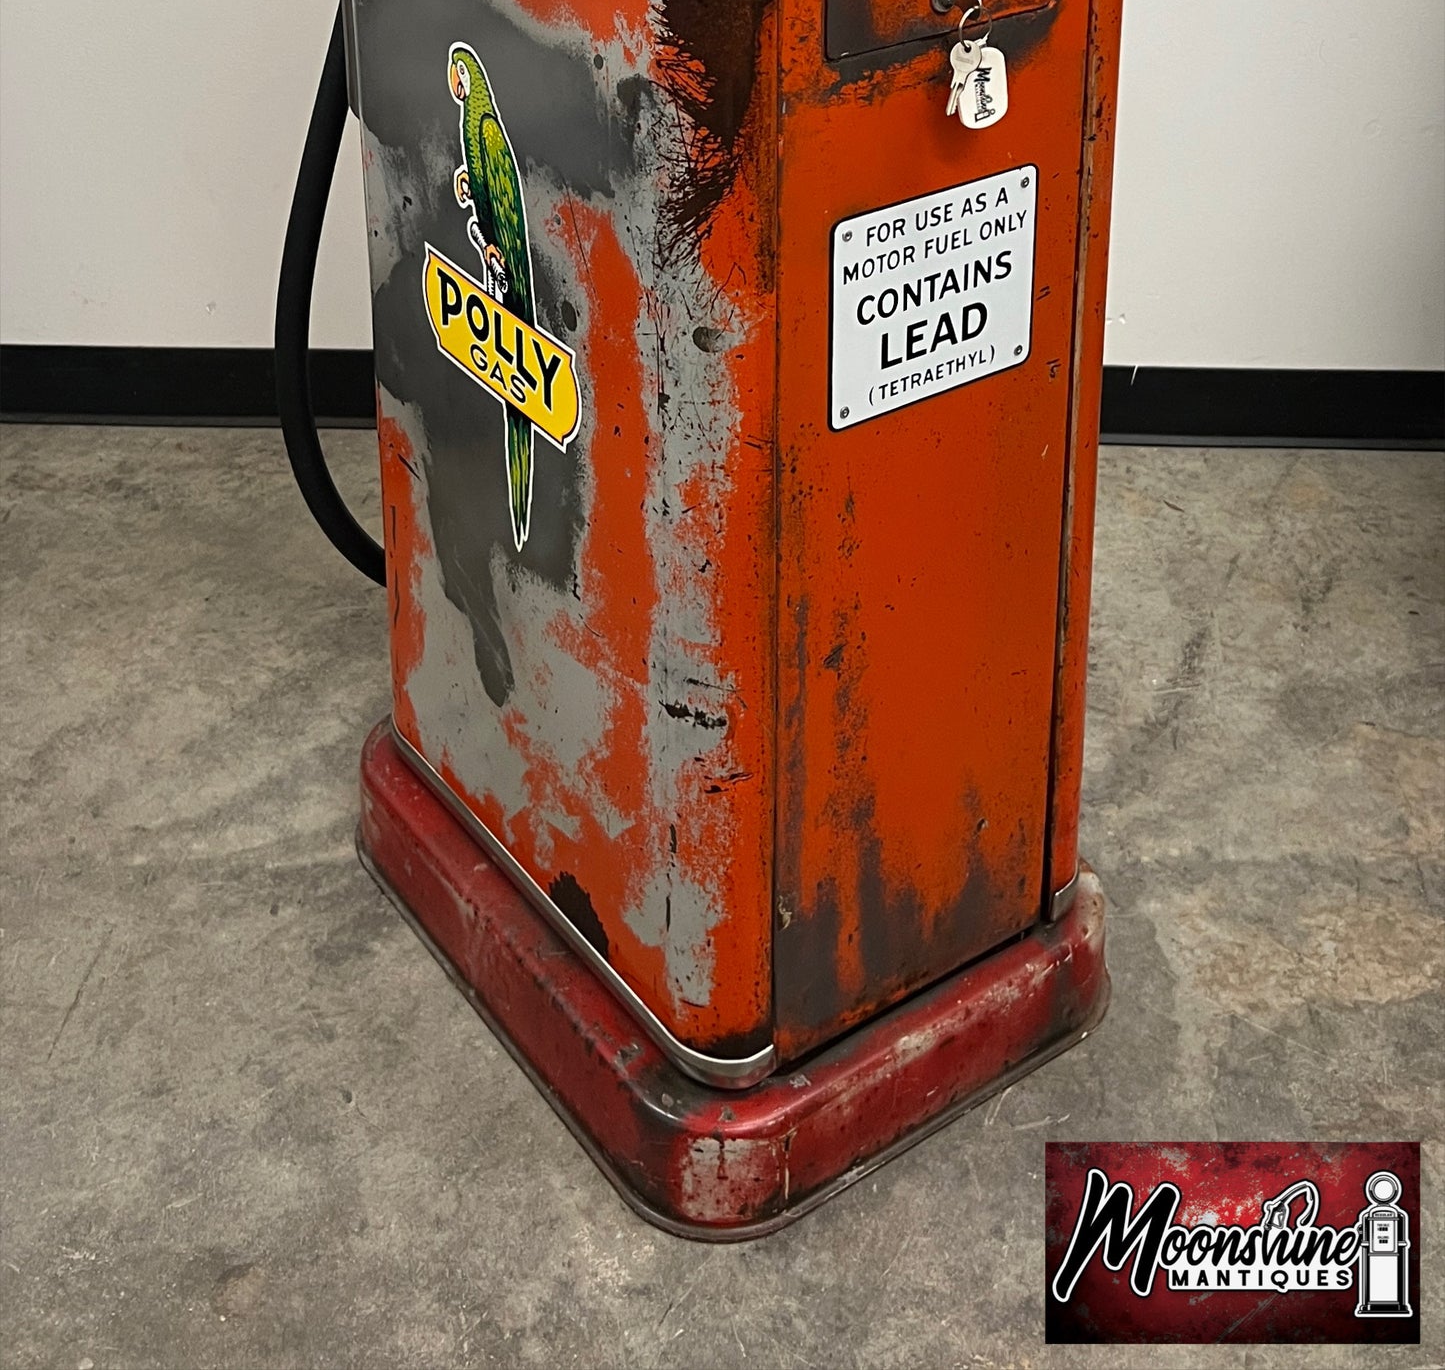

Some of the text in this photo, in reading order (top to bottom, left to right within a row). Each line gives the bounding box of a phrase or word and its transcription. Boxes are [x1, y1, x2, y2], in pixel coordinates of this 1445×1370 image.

[843, 210, 1027, 284] MOTOR FUEL ONLY
[866, 187, 1009, 246] FOR USE AS A
[857, 251, 1012, 325] CONTAINS
[437, 267, 561, 412] POLLY
[881, 302, 988, 369] LEAD
[470, 344, 526, 404] GAS
[868, 345, 995, 406] (TETRAETHYL)
